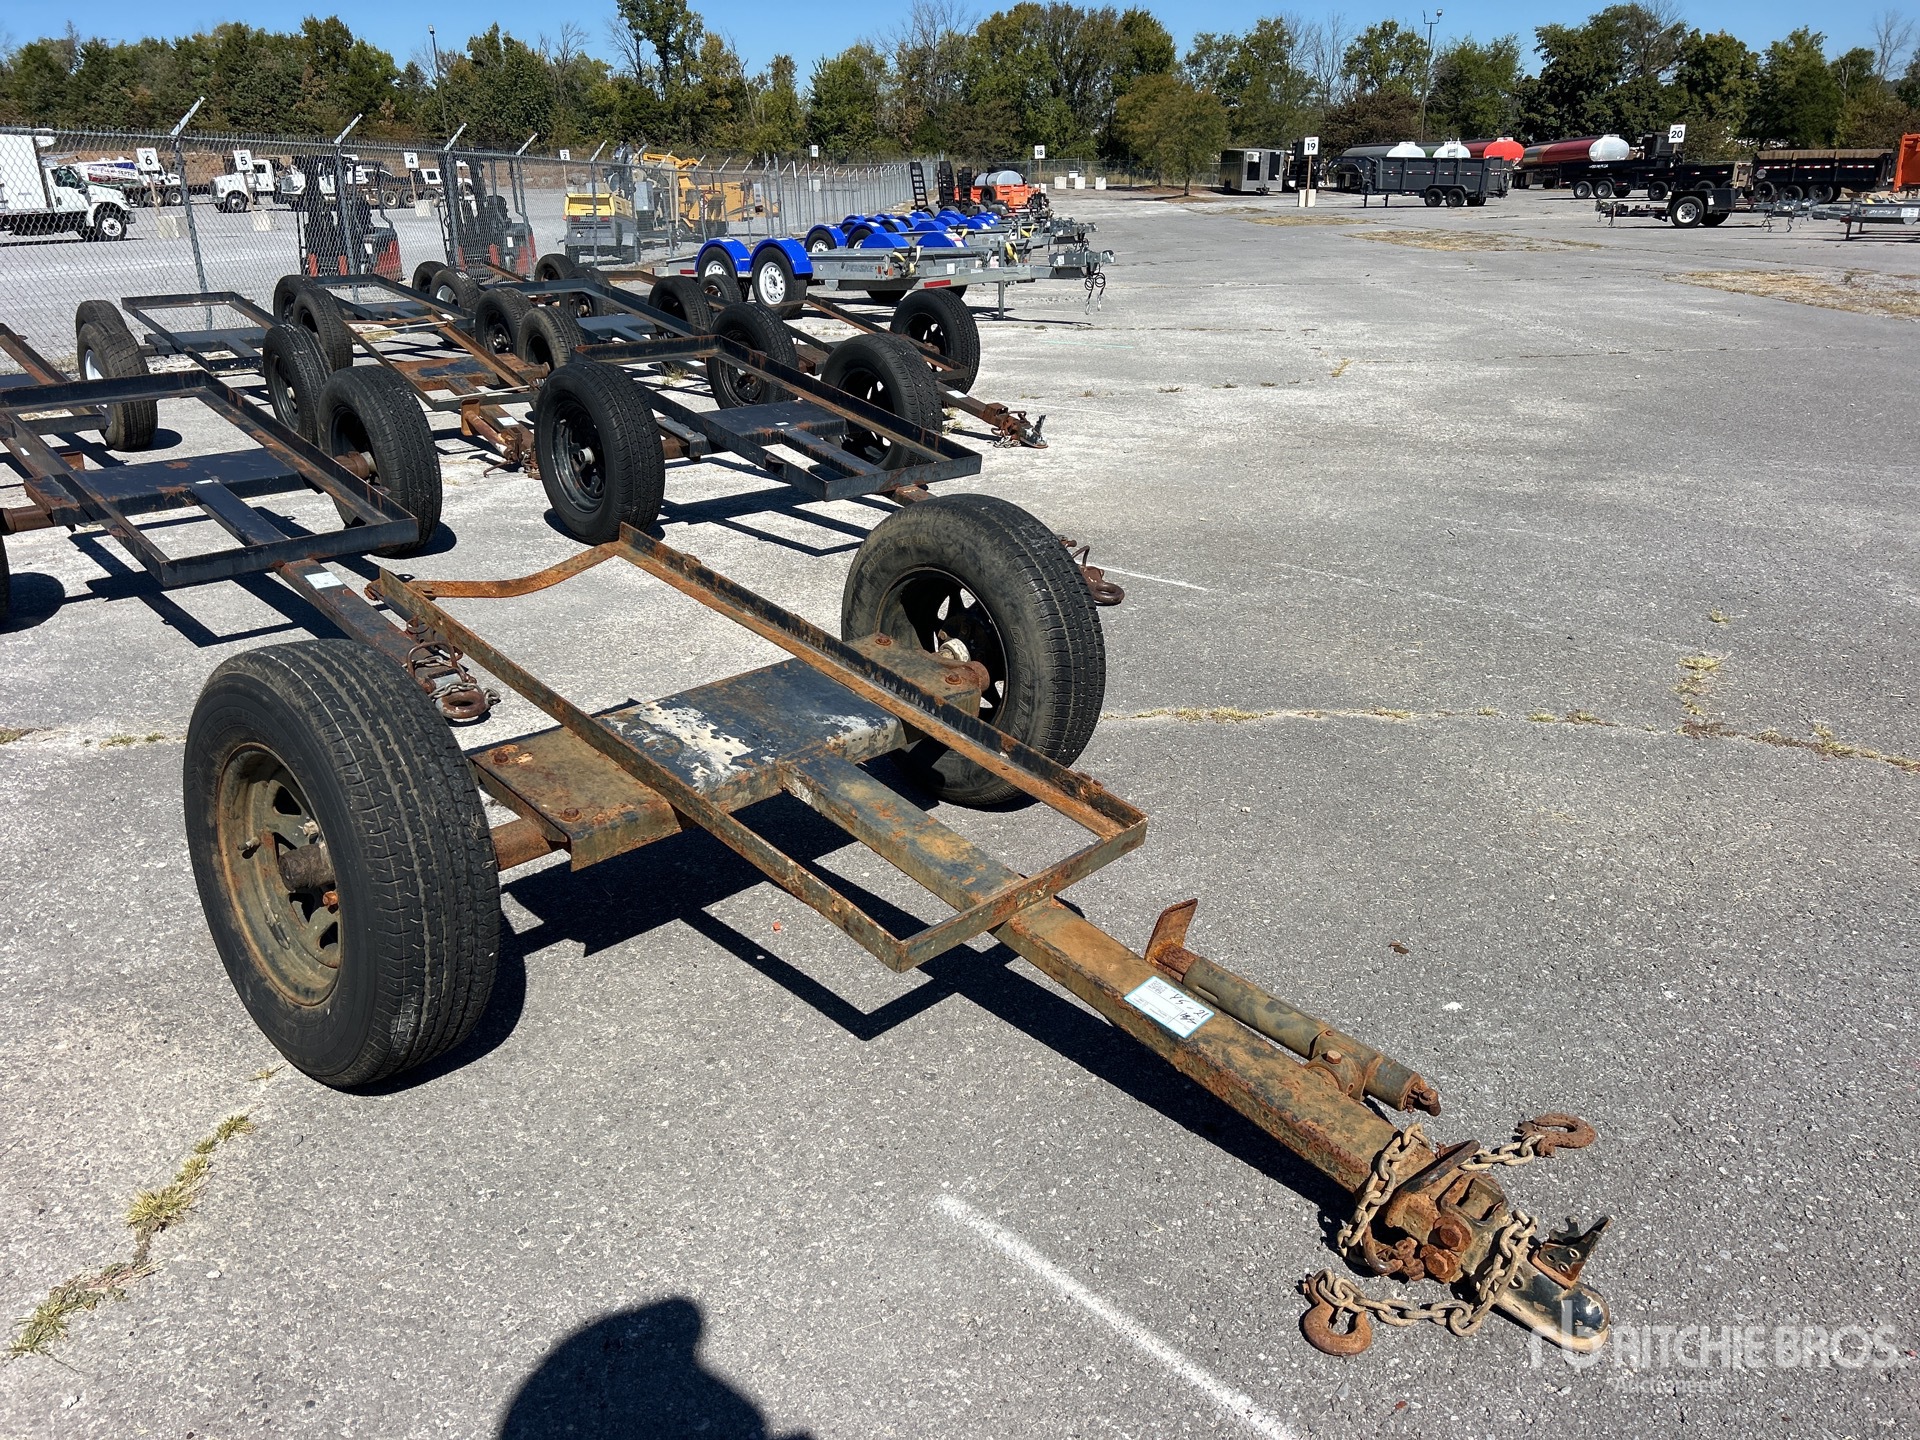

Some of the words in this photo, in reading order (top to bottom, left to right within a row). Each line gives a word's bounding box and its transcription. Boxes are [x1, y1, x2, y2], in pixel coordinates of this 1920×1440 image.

[1671, 130, 1683, 138] 20
[1307, 142, 1316, 151] 19
[145, 155, 153, 165] 6
[240, 156, 248, 166] 5
[408, 156, 415, 164] 4
